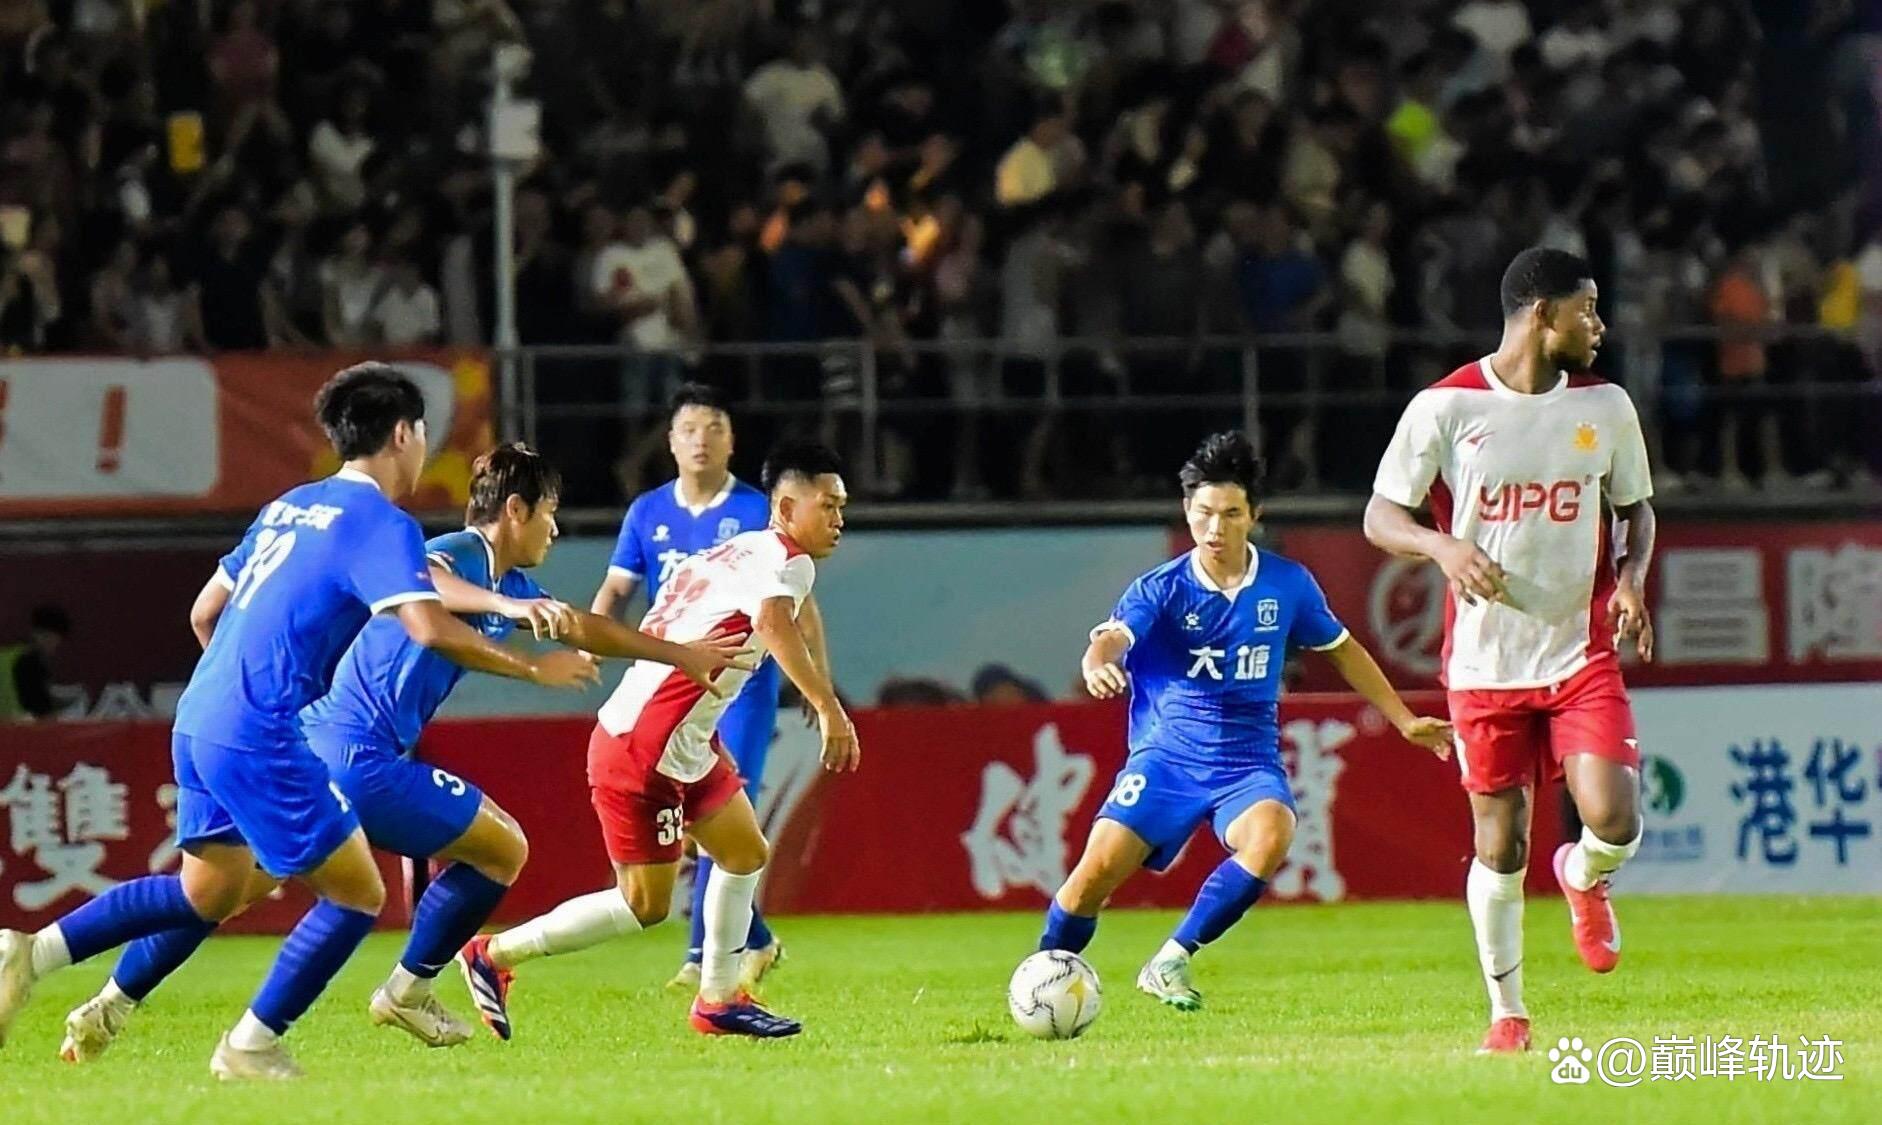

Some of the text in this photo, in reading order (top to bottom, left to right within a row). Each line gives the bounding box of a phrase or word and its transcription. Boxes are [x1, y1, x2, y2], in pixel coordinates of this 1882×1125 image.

[657, 548, 706, 583] 大
[1186, 645, 1272, 681] 大塘
[432, 768, 466, 797] 3
[1727, 737, 1882, 866] 港华
